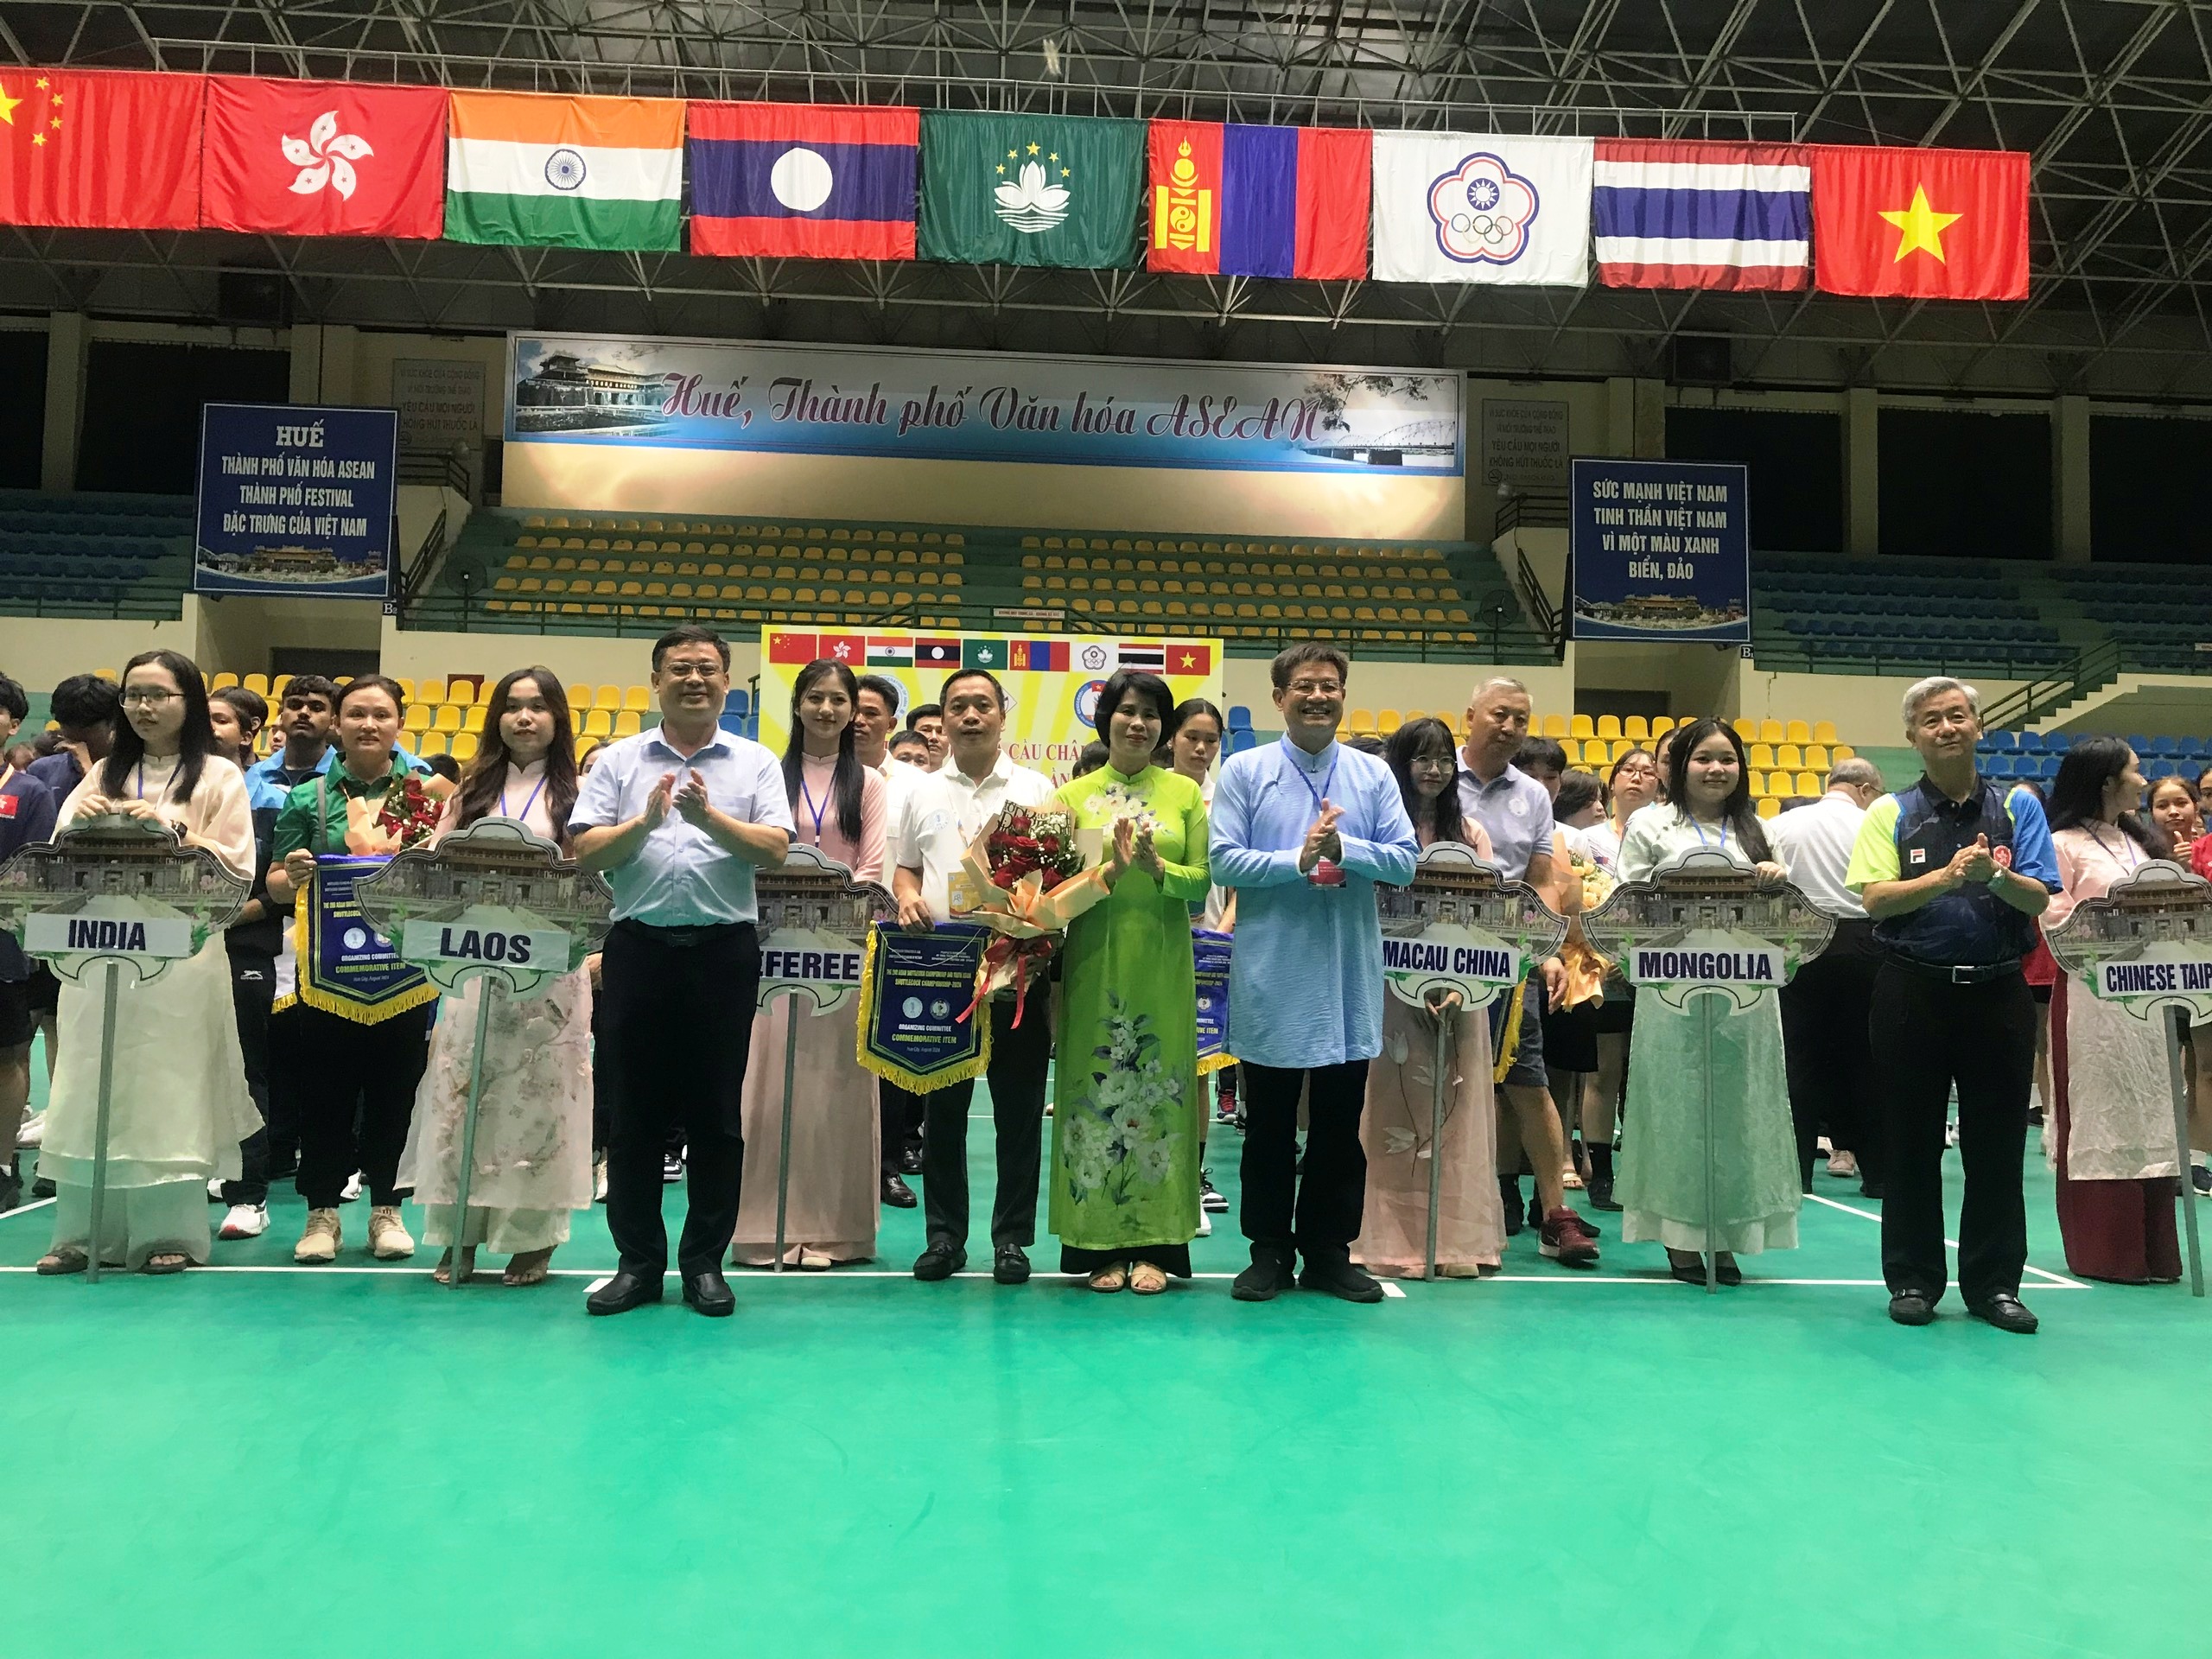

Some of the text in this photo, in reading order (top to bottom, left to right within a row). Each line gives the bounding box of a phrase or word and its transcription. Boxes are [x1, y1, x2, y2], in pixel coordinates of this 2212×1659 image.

[660, 372, 1323, 442] Huế, Thành phố Văn hóa ASEAN
[276, 419, 325, 448] HUẾ
[221, 451, 375, 480] THÀNH PHỐ VĂN HÓA ASEAN
[239, 480, 354, 508] THÀNH PHỐ FESTIVAL
[1592, 478, 1728, 505] SỨC MẠNH VIỆT NAM
[223, 510, 368, 540] ĐẶC TRƯNG CỦA VIỆT NAM
[1593, 503, 1727, 531] TINH THẦN VIỆT NAM
[1602, 531, 1720, 556] VÌ MỘT MÀU XANH
[1667, 557, 1694, 580] ĐẢO
[67, 918, 147, 951] INDIA
[439, 926, 531, 964] LAOS
[335, 962, 406, 974] COMMEMORATIVE ITEM
[760, 950, 861, 981] FEREE
[1382, 940, 1510, 978] MACAU CHINA
[1637, 951, 1773, 981] MONGOLIA
[2106, 964, 2177, 993] CHINESE
[892, 1033, 942, 1044] COMMEMORATIVE
